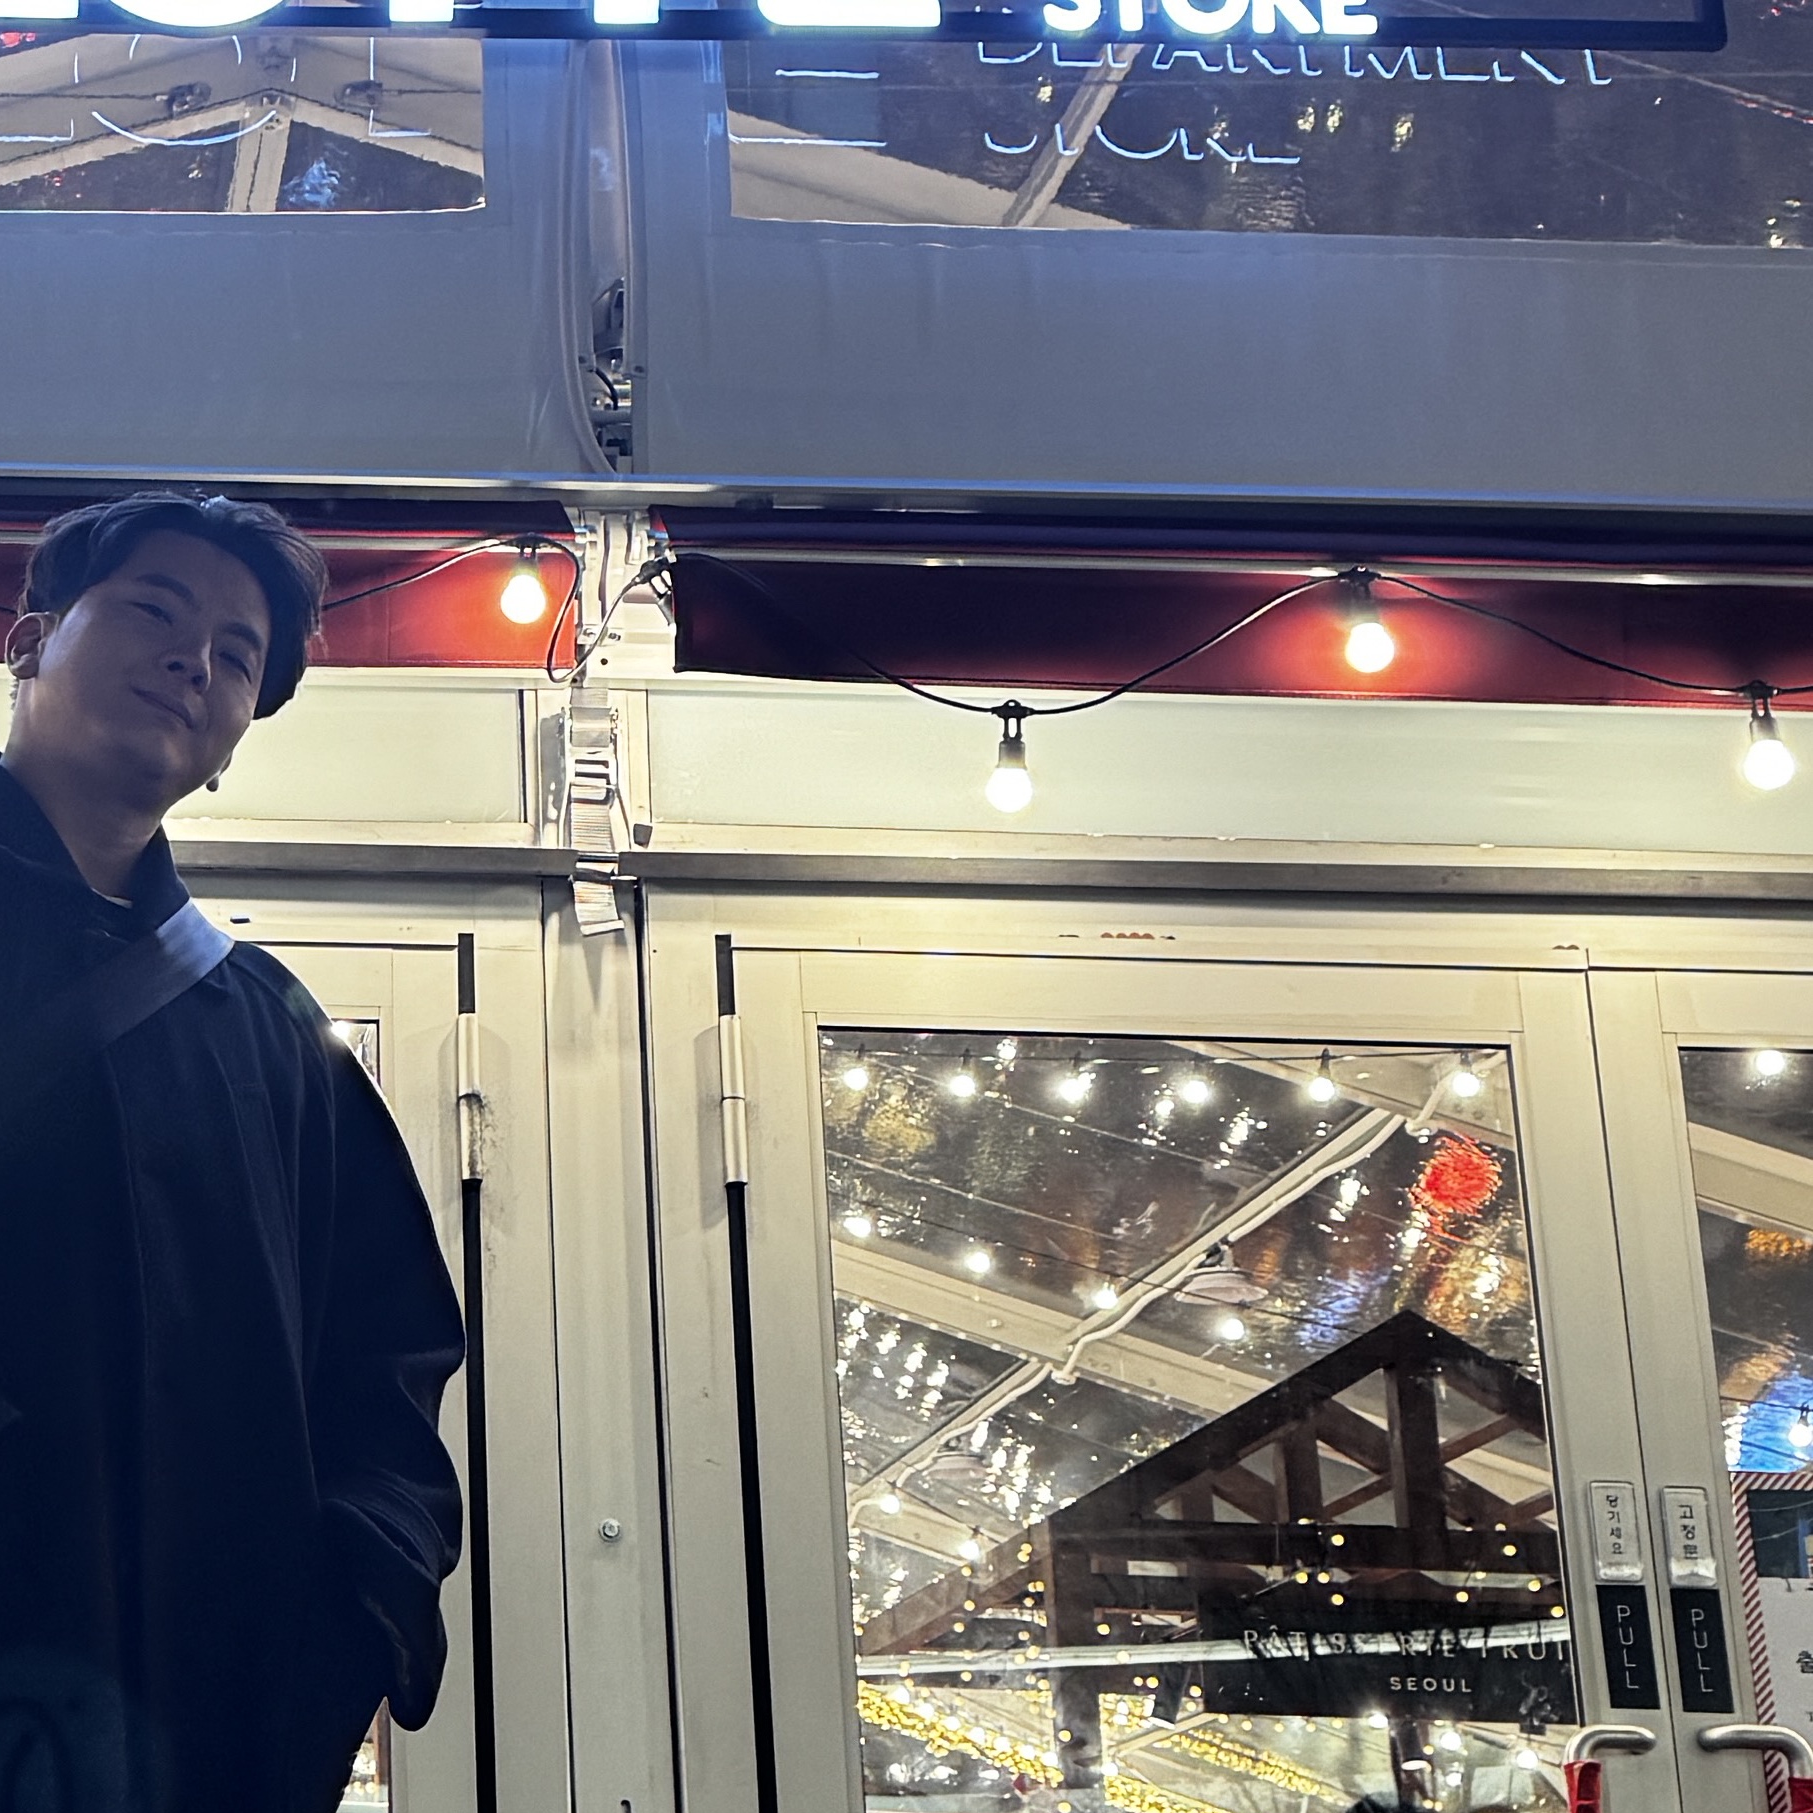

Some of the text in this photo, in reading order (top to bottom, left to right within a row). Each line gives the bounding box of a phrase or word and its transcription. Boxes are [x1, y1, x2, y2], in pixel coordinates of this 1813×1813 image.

[1606, 1494, 1623, 1555] 당기세요
[1617, 1604, 1640, 1689] PULL
[1691, 1608, 1714, 1693] PULL
[1390, 1676, 1472, 1693] SEOUL
